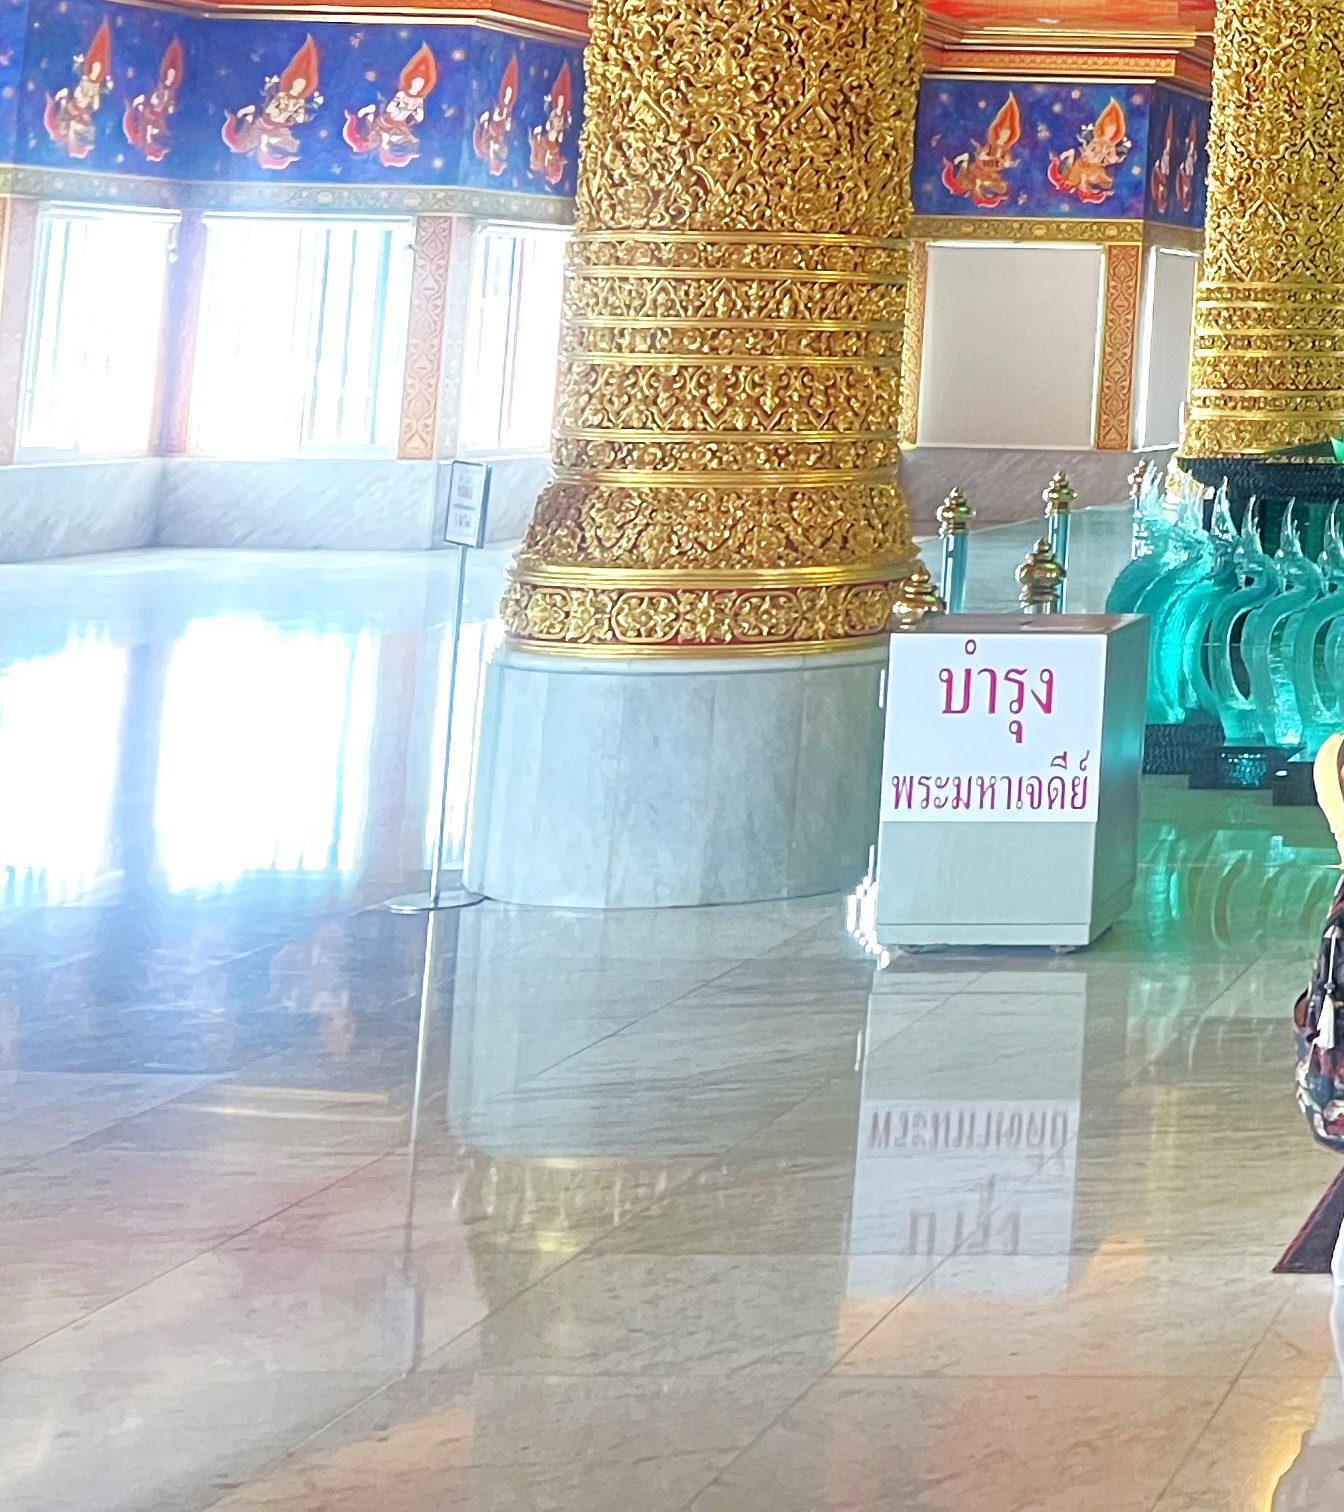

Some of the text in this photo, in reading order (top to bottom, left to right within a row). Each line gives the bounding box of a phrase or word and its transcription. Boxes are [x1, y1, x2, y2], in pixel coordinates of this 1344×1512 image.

[938, 639, 1054, 744] บำรุง
[891, 750, 1090, 810] พระมหาเจดีย์
